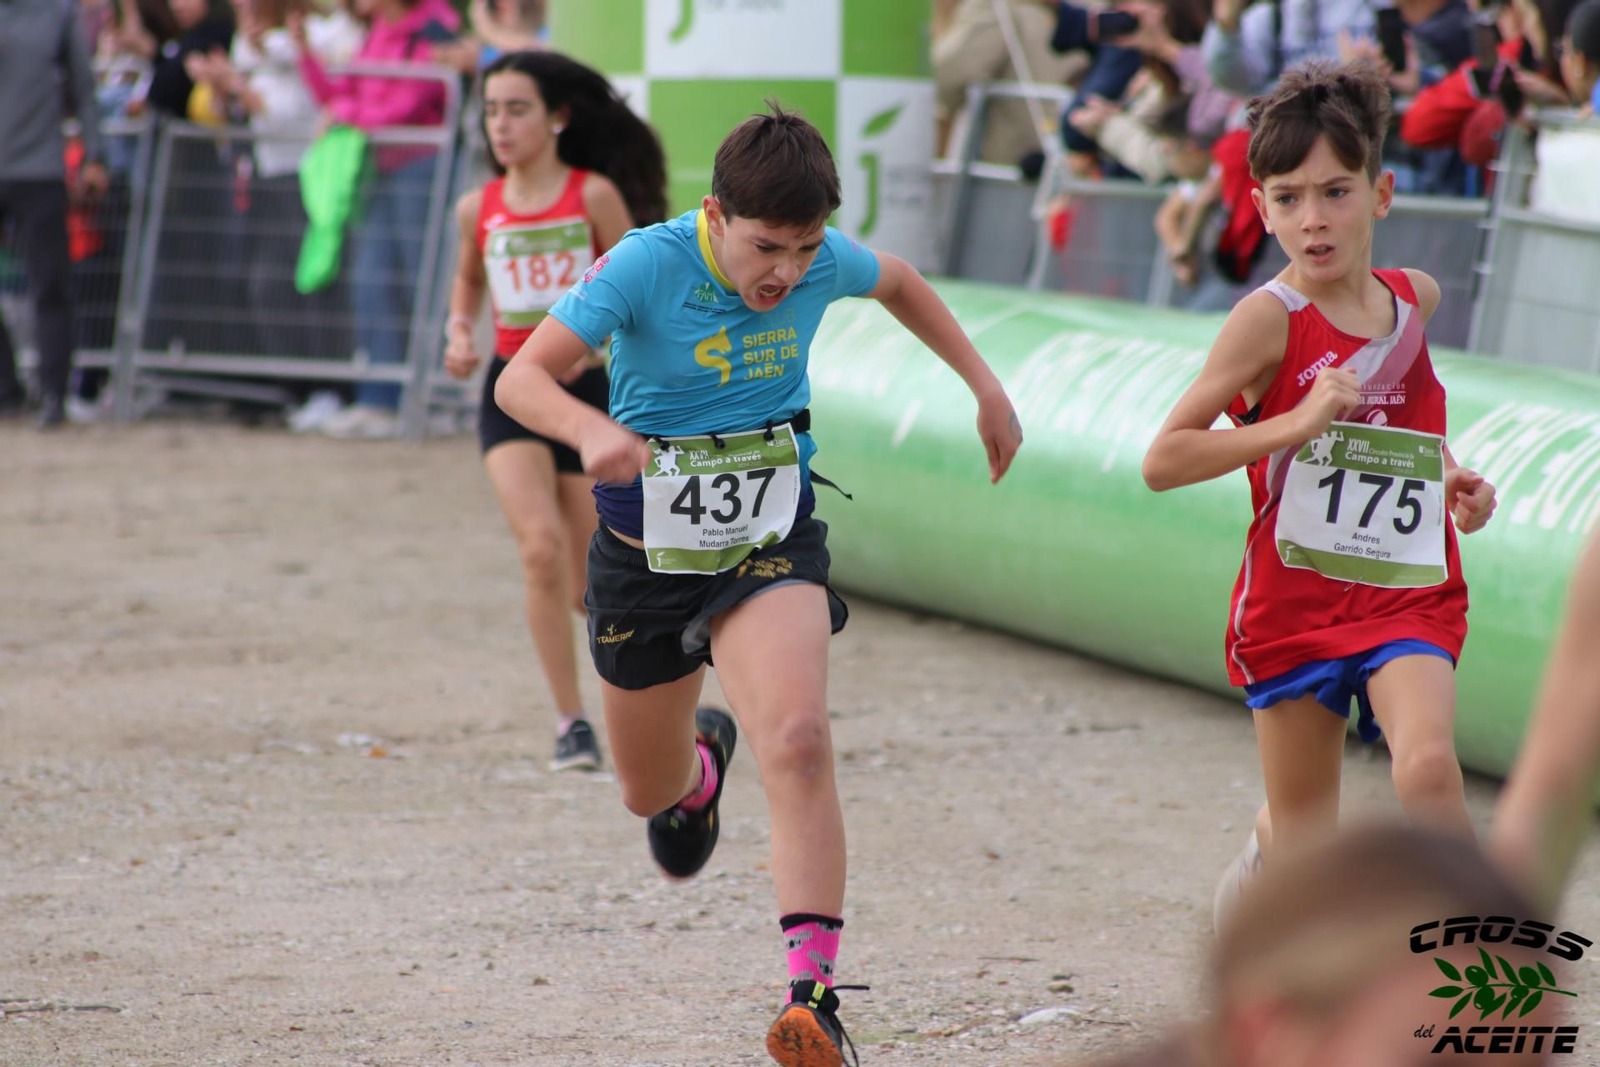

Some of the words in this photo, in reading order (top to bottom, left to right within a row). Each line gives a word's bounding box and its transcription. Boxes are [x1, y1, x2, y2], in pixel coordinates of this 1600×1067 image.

[503, 251, 578, 294] 182
[742, 326, 797, 349] SIERRA
[743, 348, 777, 366] SUR
[780, 344, 799, 360] DE
[743, 362, 786, 381] JAÉN
[1346, 438, 1370, 453] XXVII
[690, 456, 723, 468] Campo
[725, 456, 731, 464] a
[734, 452, 762, 463] través
[1345, 451, 1380, 465] Campo
[1390, 457, 1415, 468] través
[670, 467, 776, 525] 437
[1318, 468, 1426, 535] 175
[702, 528, 724, 536] Pablo
[725, 524, 749, 535] Manuel
[1351, 532, 1381, 545] Andres
[699, 540, 729, 548] Mudarra
[730, 535, 749, 545] Torres
[1333, 542, 1364, 555] Garrido
[1364, 547, 1391, 559] Segura
